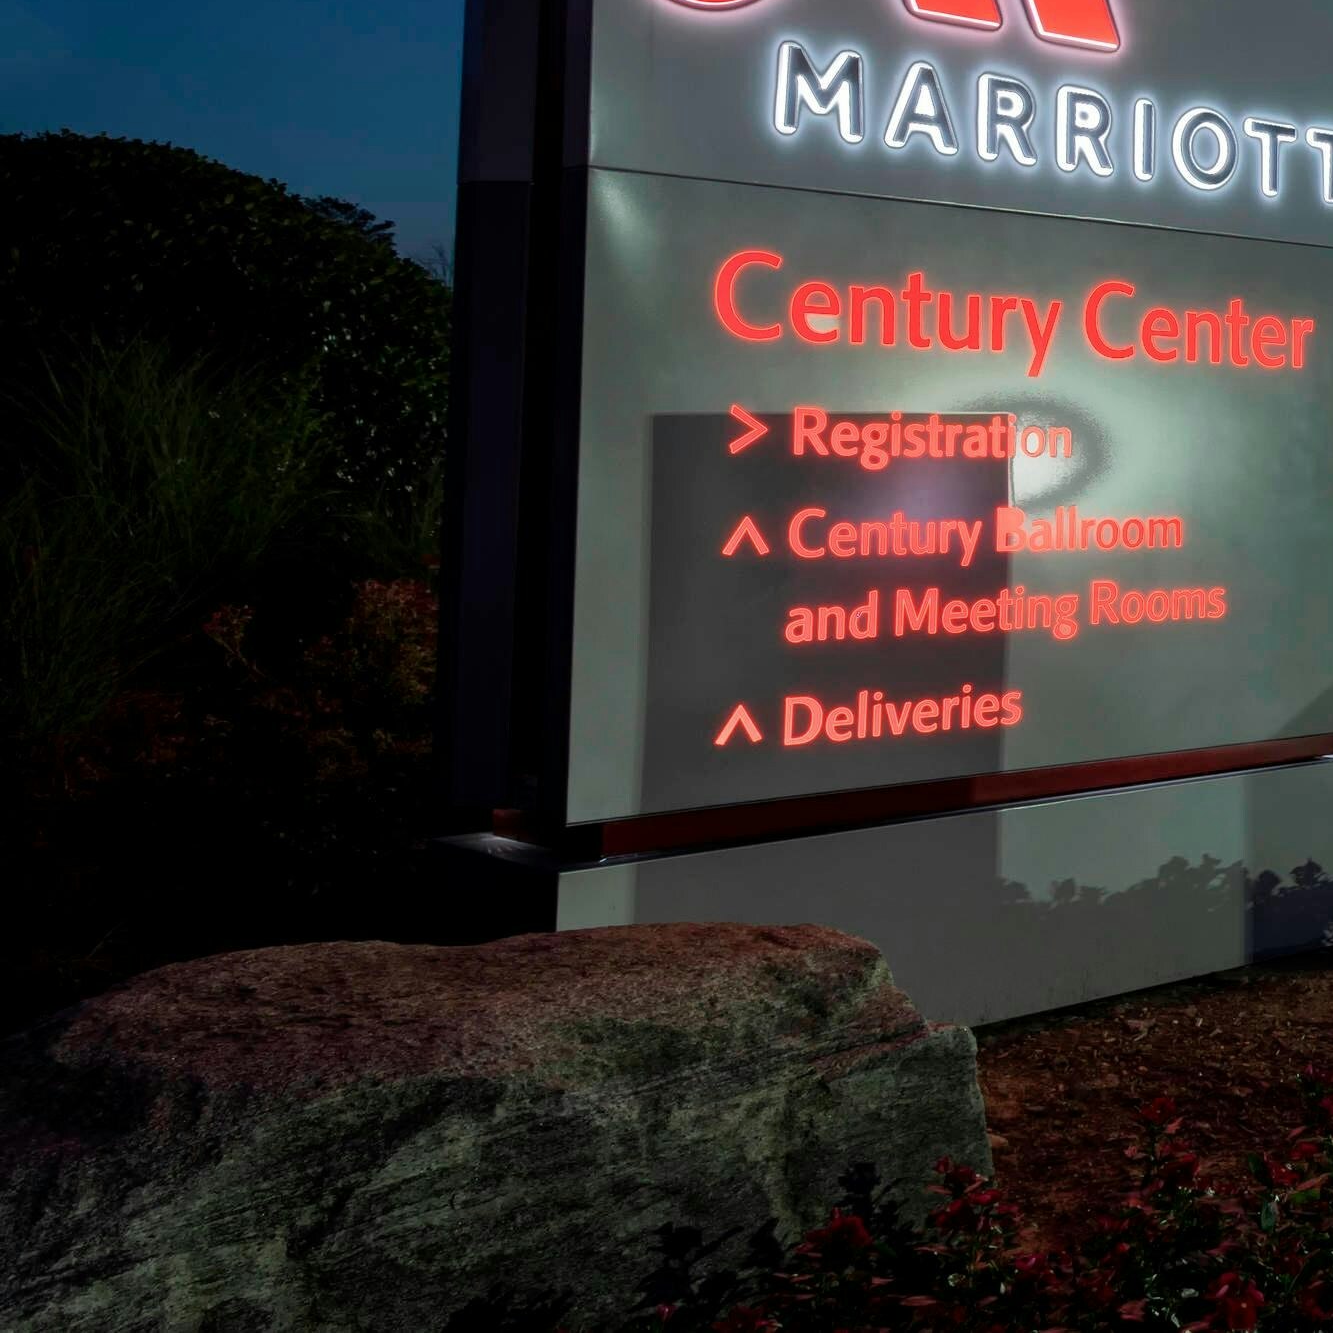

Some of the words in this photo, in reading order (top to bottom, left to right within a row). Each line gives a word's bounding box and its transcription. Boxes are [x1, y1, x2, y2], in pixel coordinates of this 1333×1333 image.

[713, 249, 1062, 377] Century
[1083, 280, 1315, 369] Center
[790, 406, 1073, 472] Registration
[787, 506, 984, 568] Century
[992, 504, 1184, 554] Ballroom
[783, 587, 881, 645] and
[891, 585, 1080, 641] Meeting
[1089, 580, 1227, 625] Rooms
[781, 683, 1023, 747] Deliveries
